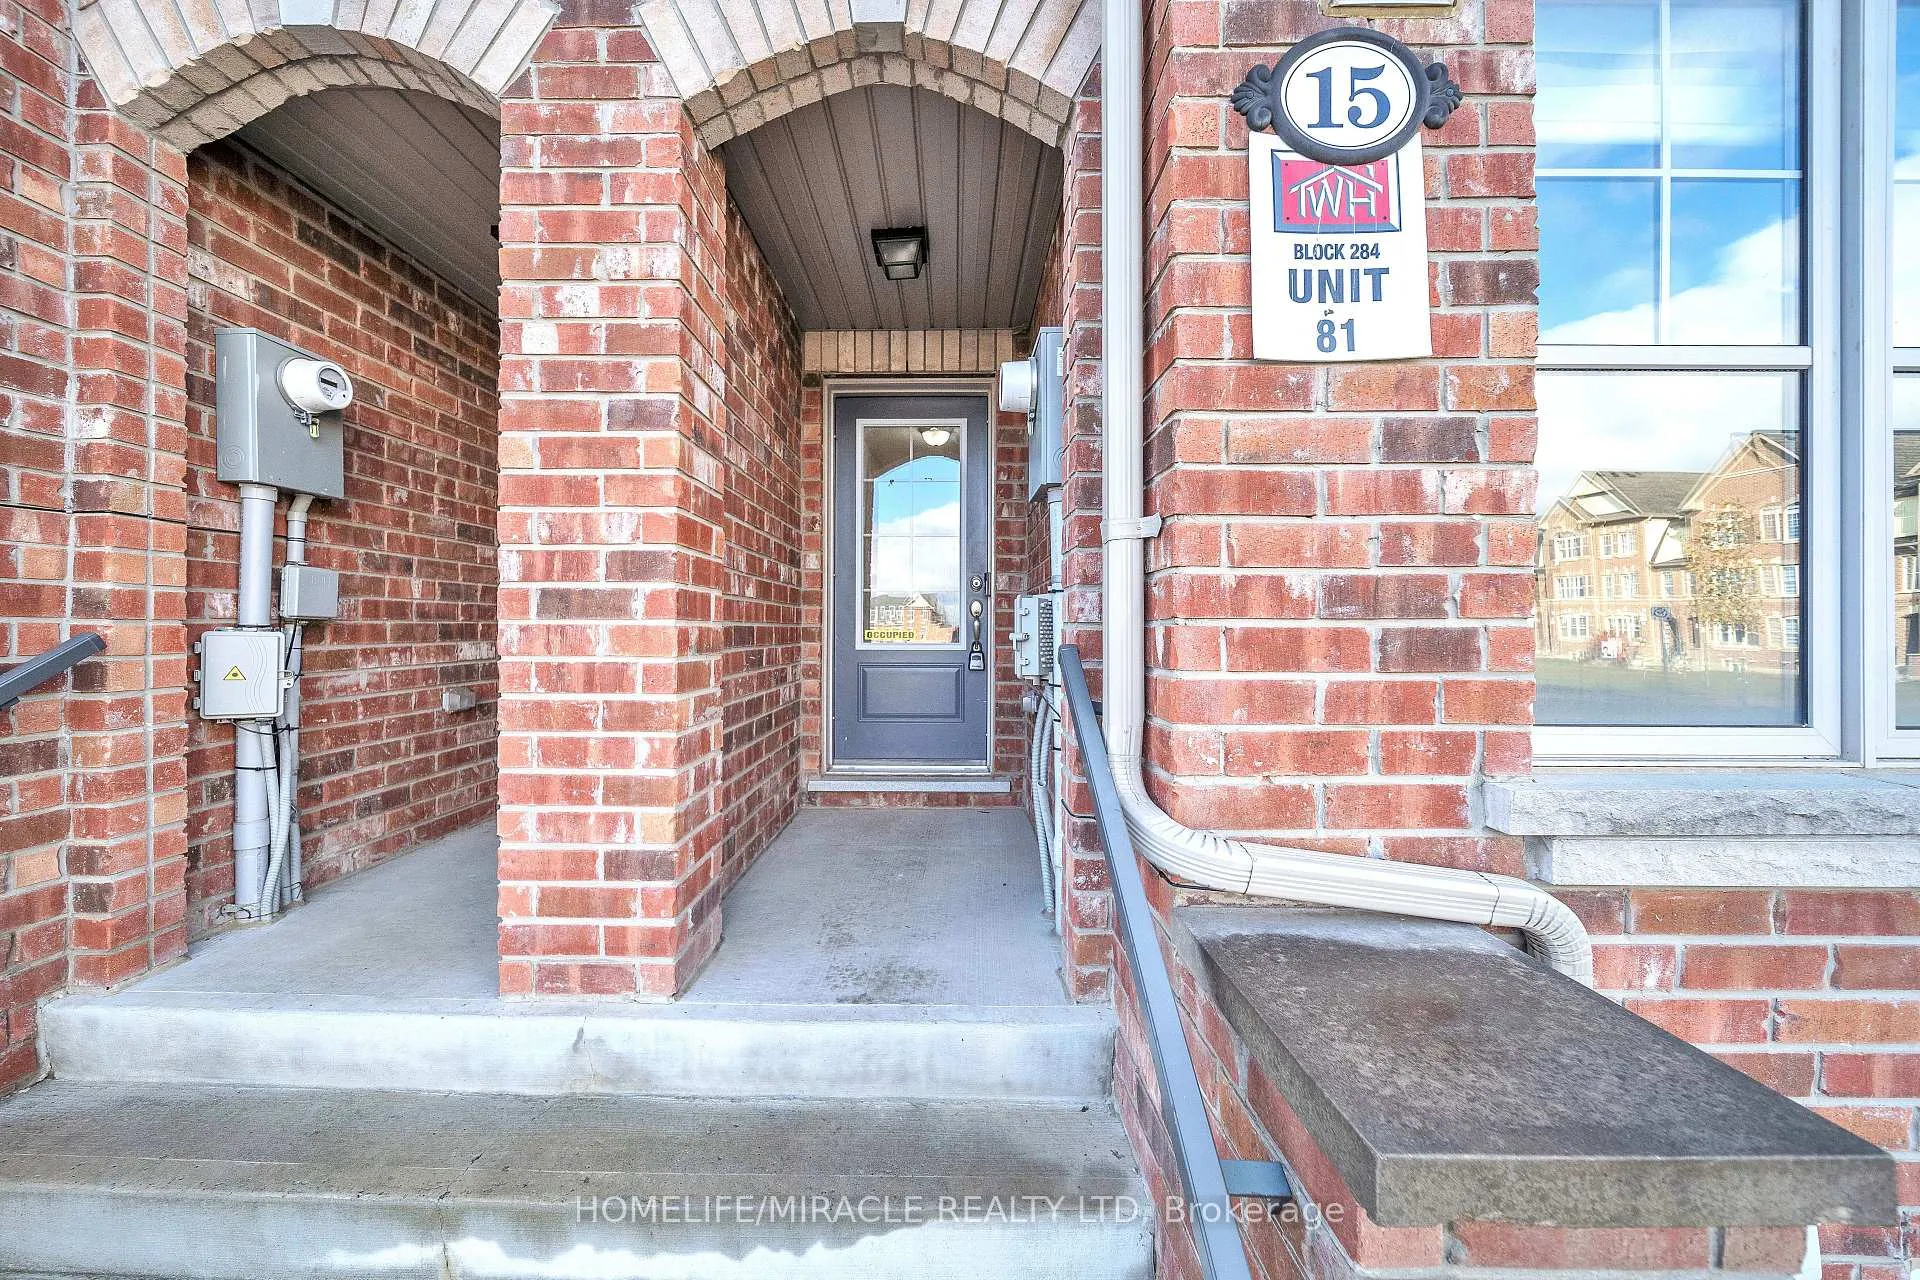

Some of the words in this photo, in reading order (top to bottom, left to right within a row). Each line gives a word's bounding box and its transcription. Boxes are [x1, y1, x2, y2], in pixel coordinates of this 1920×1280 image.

[1305, 64, 1391, 129] 15
[1294, 242, 1345, 261] BLOCK
[1350, 242, 1381, 260] 284
[1288, 268, 1390, 304] UNIT
[1316, 318, 1356, 353] 81
[866, 631, 915, 639] OCCUPIED
